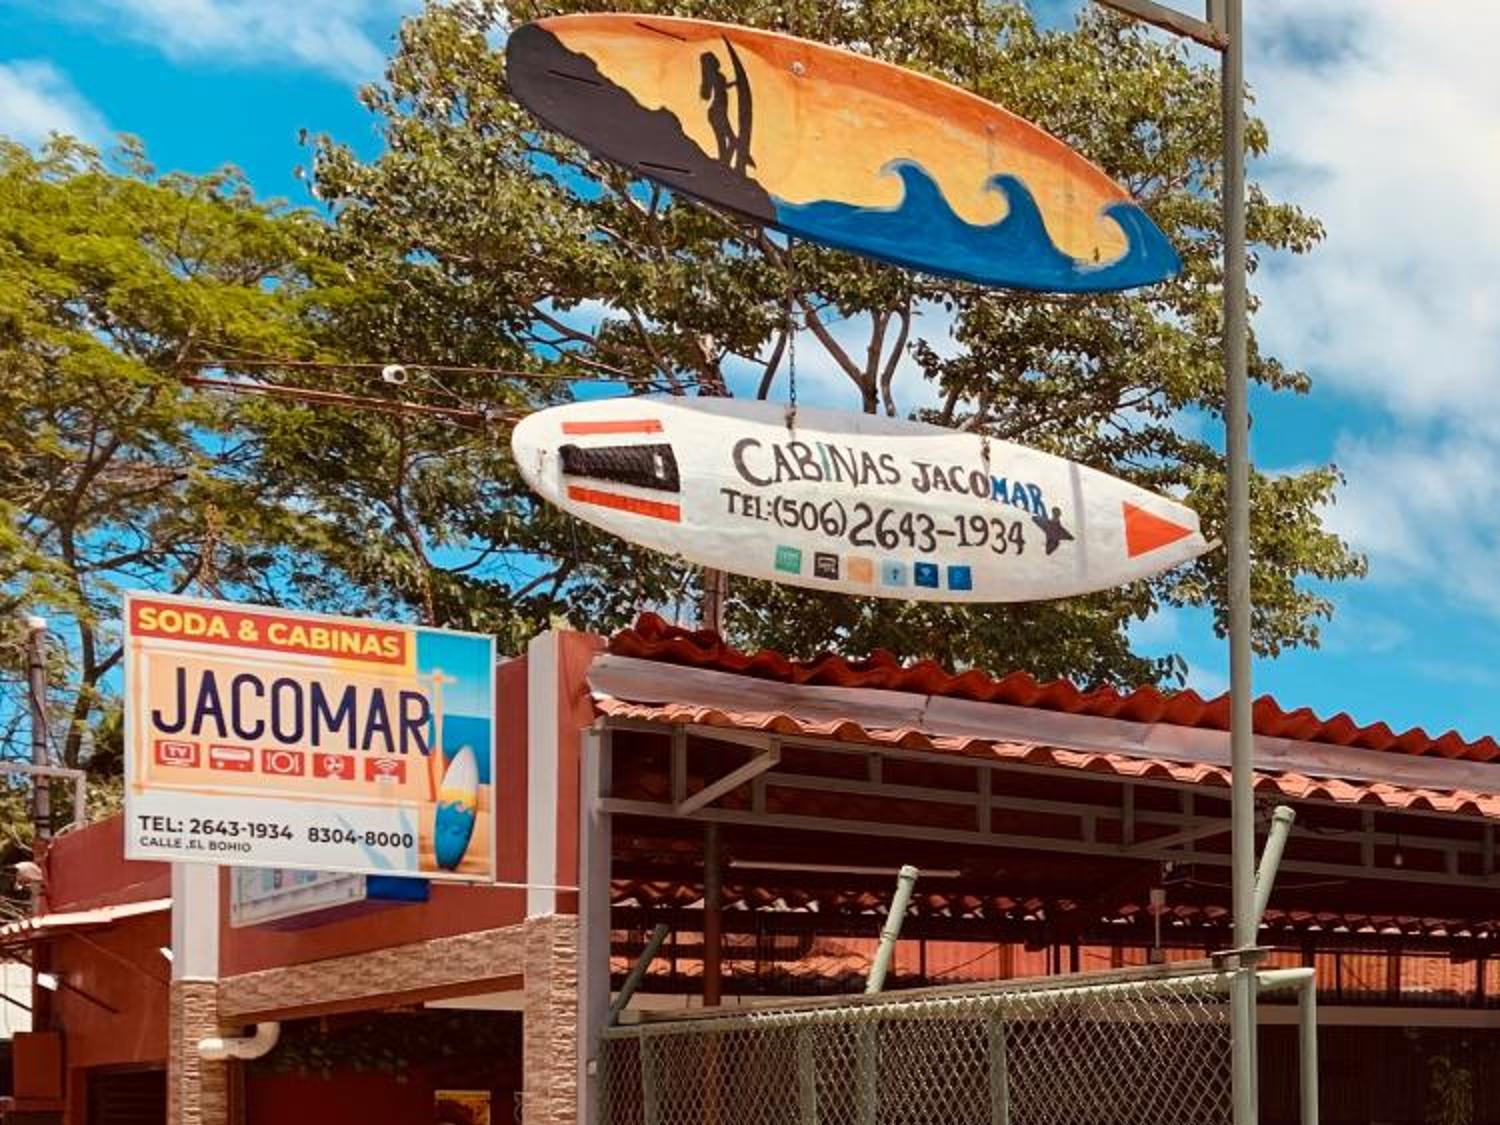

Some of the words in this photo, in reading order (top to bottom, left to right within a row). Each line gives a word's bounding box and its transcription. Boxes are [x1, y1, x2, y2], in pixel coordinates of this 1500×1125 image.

[732, 438, 901, 487] CABINAS
[912, 461, 1048, 517] JACOMAR
[138, 607, 229, 639] SODA
[238, 619, 259, 642] &
[267, 623, 400, 658] CABINAS
[151, 667, 431, 756] JACOMAR
[138, 815, 184, 832] TEL:
[190, 818, 293, 841] 2643-1934
[308, 827, 413, 849] 8304-8000
[139, 836, 182, 849] CALLE
[208, 840, 252, 853] BOHIO
